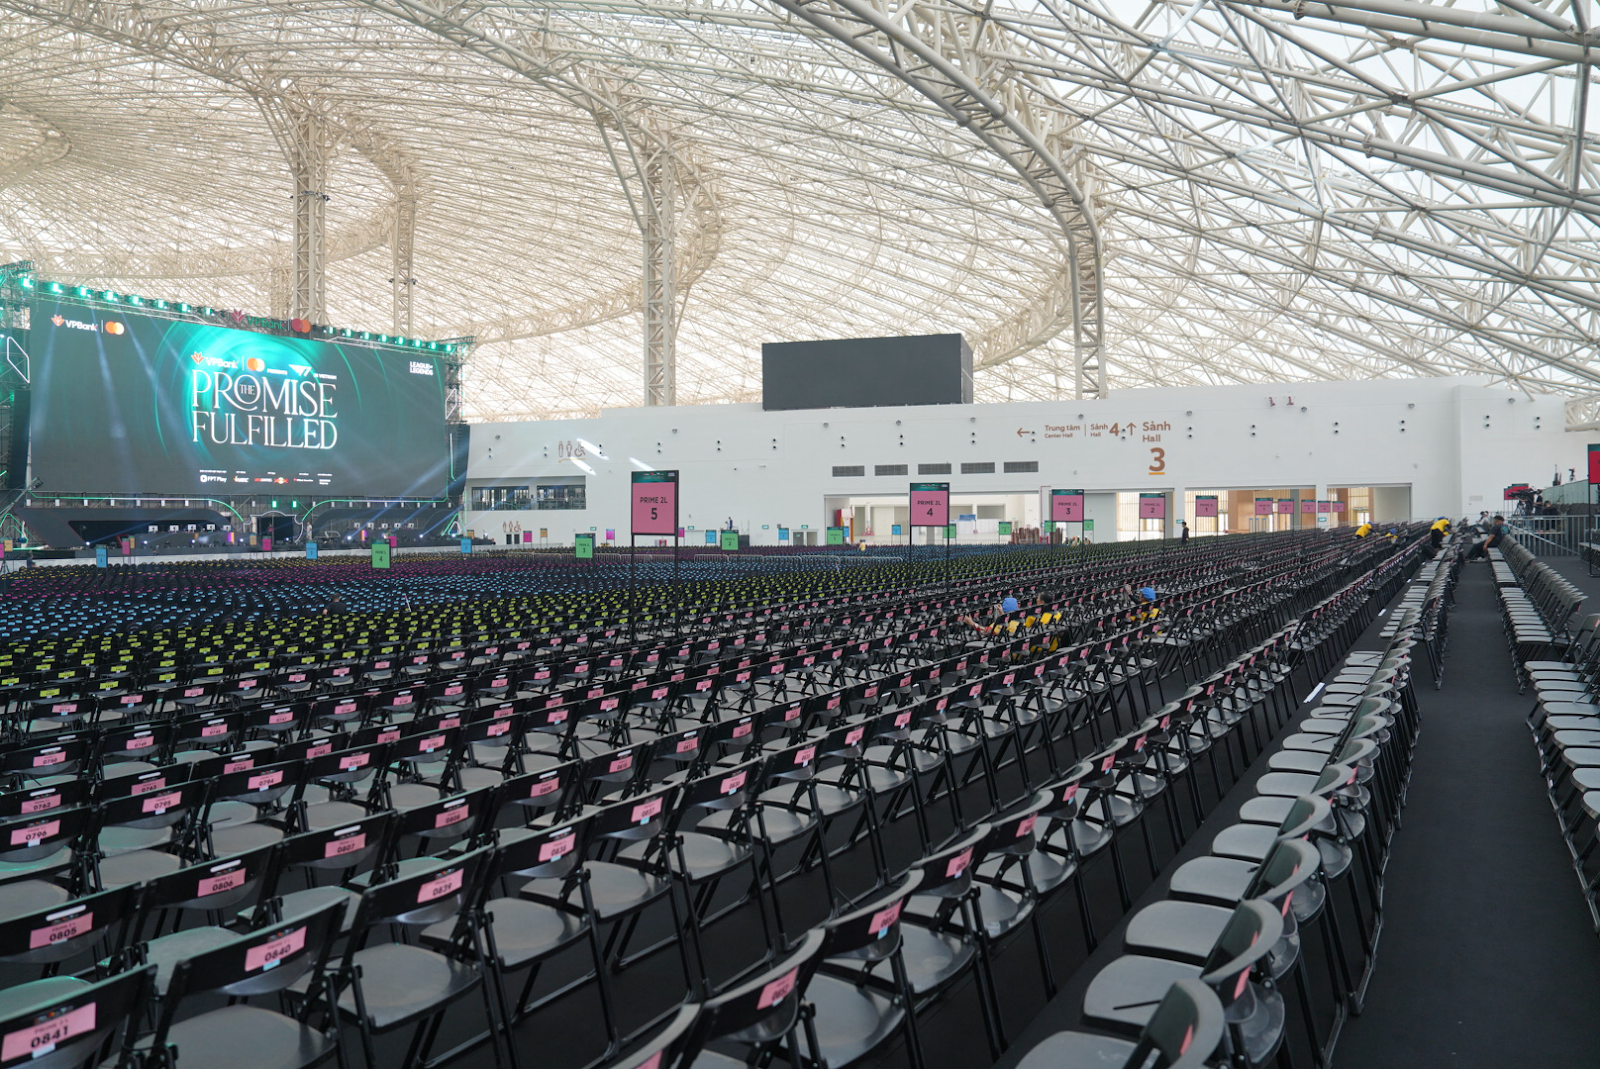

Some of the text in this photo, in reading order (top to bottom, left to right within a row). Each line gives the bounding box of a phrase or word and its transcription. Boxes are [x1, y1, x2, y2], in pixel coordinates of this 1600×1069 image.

[65, 319, 98, 331] VPBank
[246, 315, 286, 331] VPBank
[205, 356, 239, 369] VPBank
[192, 369, 338, 418] PROMISE
[239, 384, 256, 396] THE
[192, 410, 338, 450] FULFILLED
[1044, 424, 1081, 433] Trung tâm
[1109, 422, 1120, 437] 4
[1142, 421, 1171, 432] Sảnh
[1142, 434, 1161, 442] Hall
[1148, 447, 1166, 472] 3
[660, 496, 668, 504] 2L
[651, 507, 658, 520] 5
[926, 508, 933, 517] 4
[258, 778, 274, 787] 0794
[33, 802, 51, 811] 0762
[154, 800, 172, 809] 0795
[25, 831, 48, 841] 0796
[337, 843, 355, 853] 0807
[212, 880, 234, 892] 0806
[49, 926, 77, 941] 0805
[264, 944, 292, 962] 0840
[30, 1025, 69, 1048] 0841
